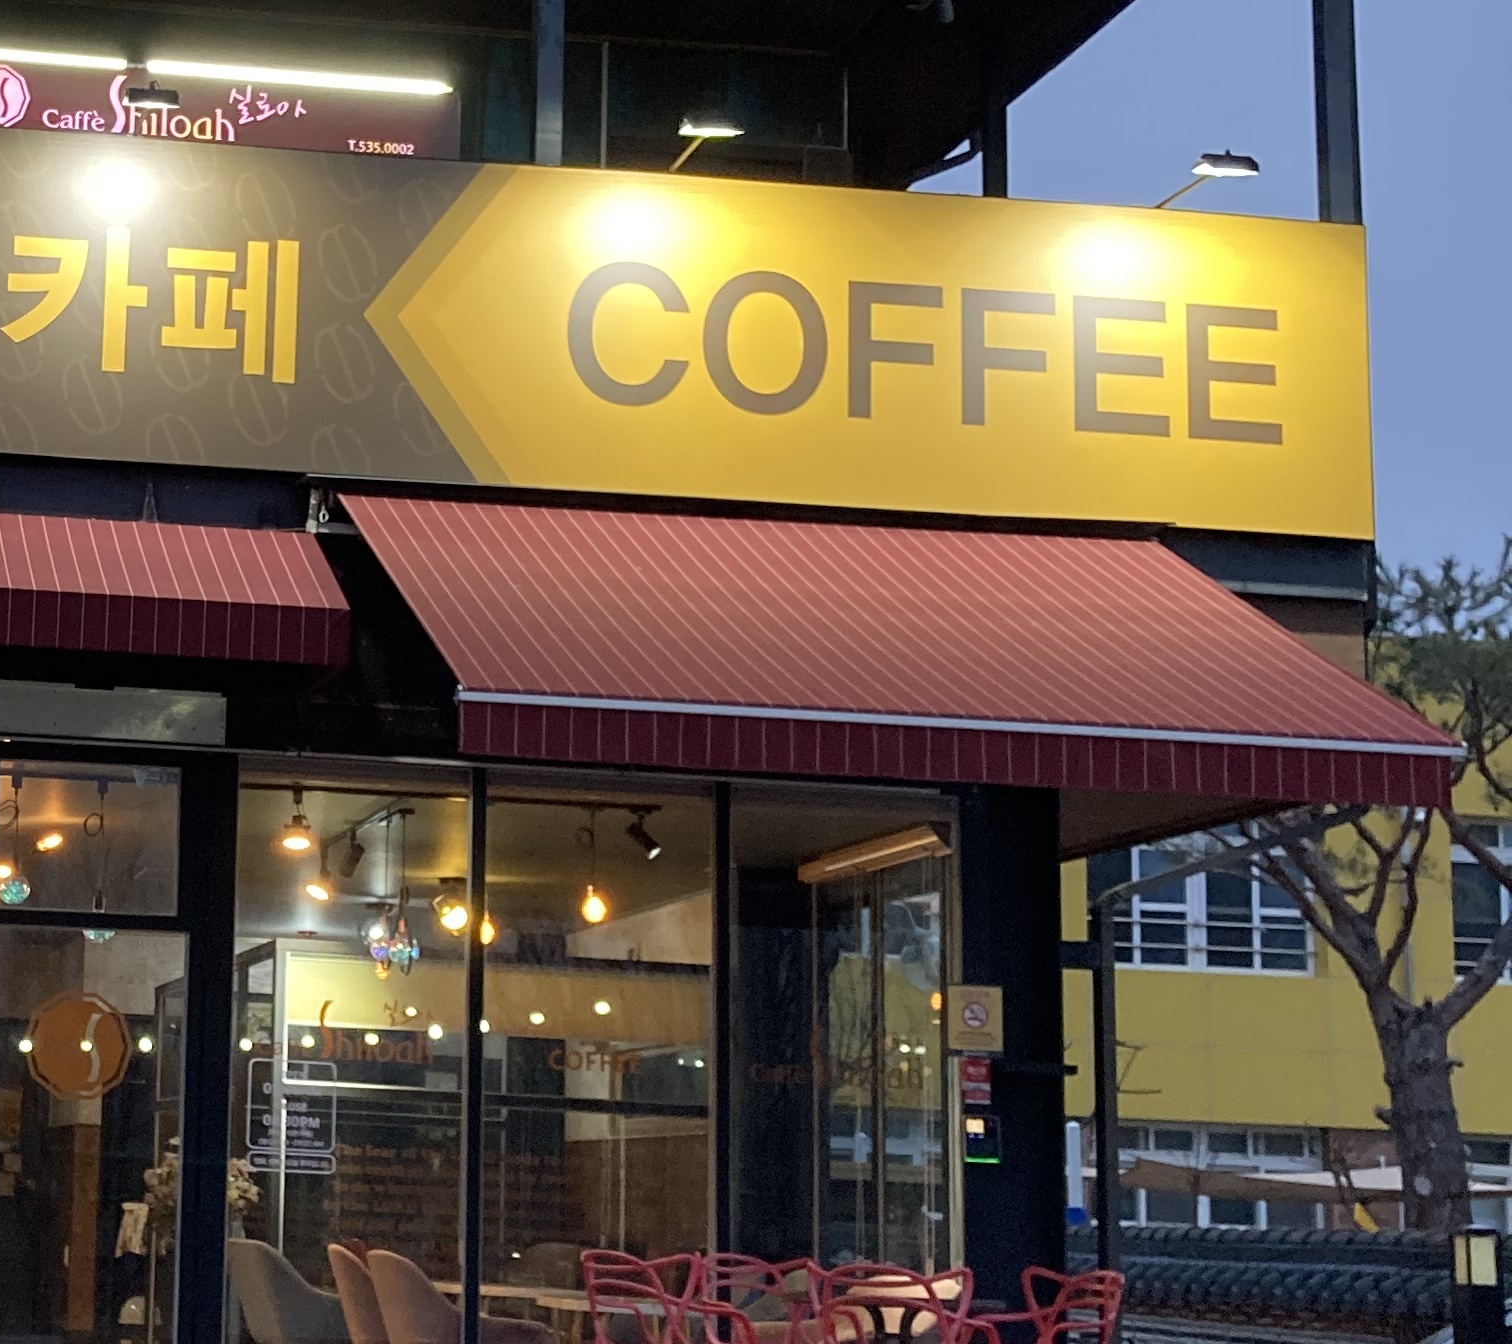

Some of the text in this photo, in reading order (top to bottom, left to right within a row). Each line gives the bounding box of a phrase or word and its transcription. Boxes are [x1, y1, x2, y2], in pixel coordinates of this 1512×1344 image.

[42, 109, 106, 132] Caffè
[228, 84, 308, 125] 실로아
[347, 139, 416, 156] T.535.0002
[0, 225, 300, 385] 카페
[567, 261, 1284, 445] COFFEE
